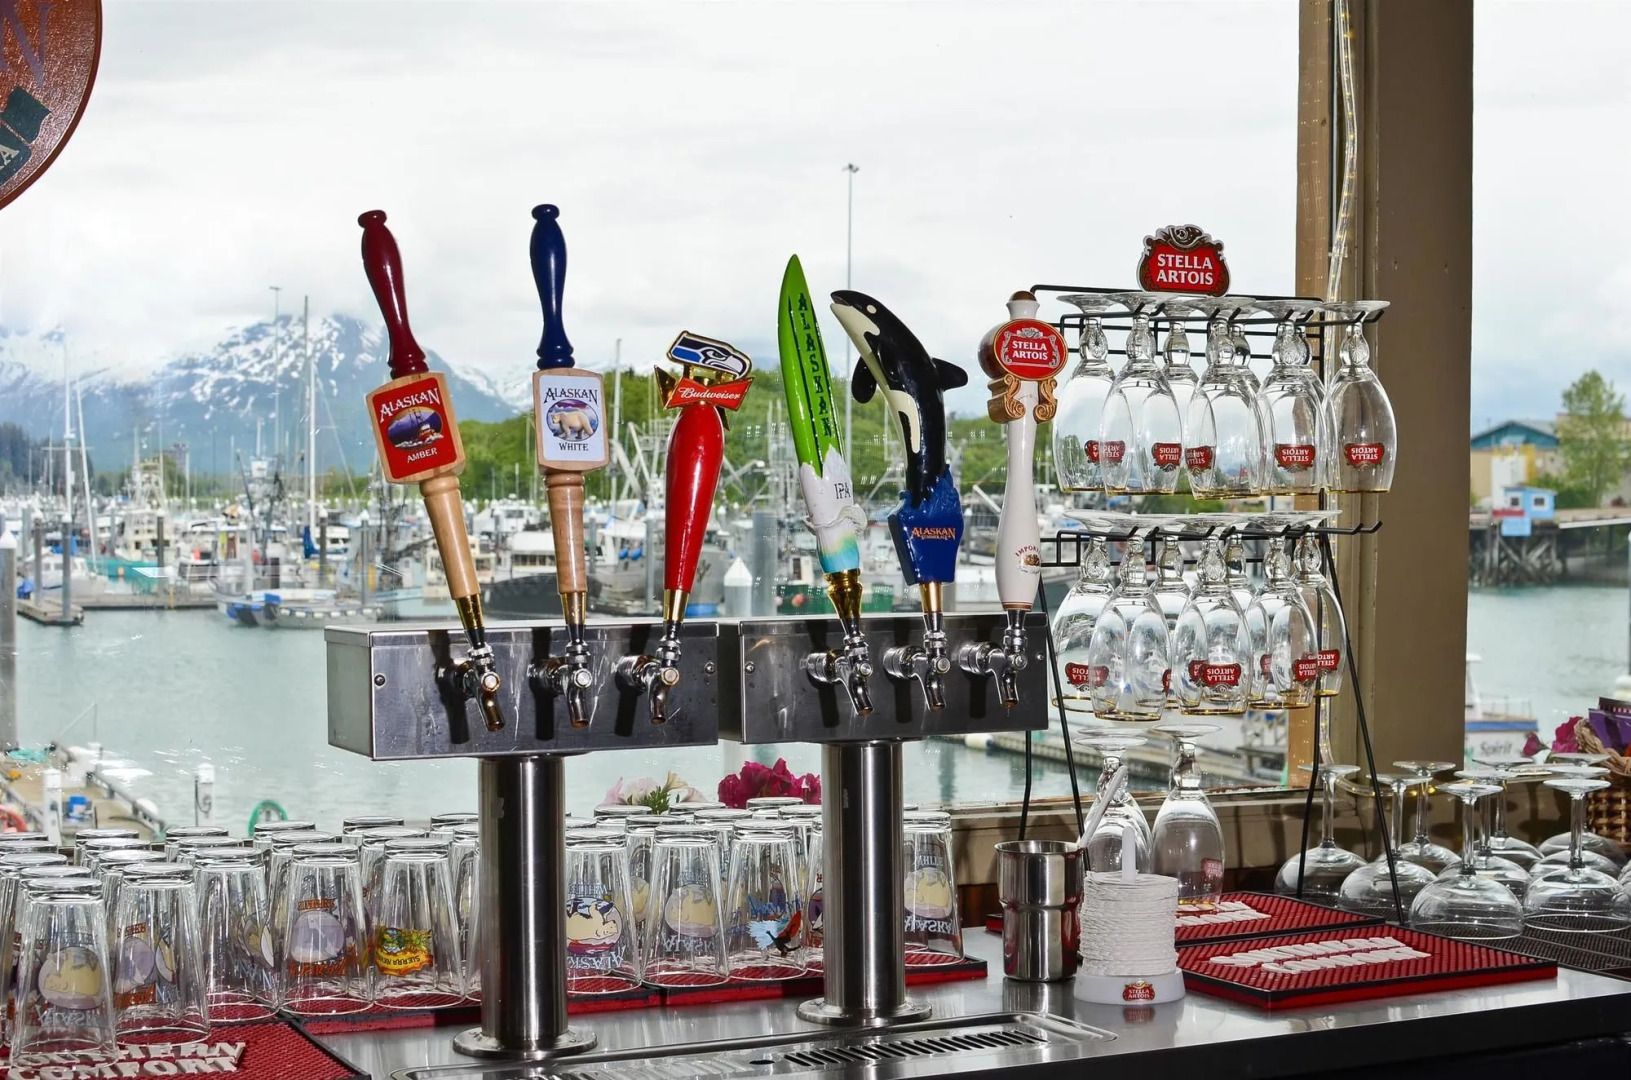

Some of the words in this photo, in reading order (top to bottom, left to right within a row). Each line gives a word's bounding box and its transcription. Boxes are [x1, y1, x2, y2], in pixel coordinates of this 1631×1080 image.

[1157, 253, 1213, 270] STELLA
[1156, 270, 1214, 285] ARTOIS
[1012, 340, 1047, 351] STELLA
[1012, 351, 1048, 360] ARTOIS
[797, 292, 832, 437] ALASKAN
[543, 387, 598, 406] ALASKAN
[678, 387, 741, 399] Budweiser
[380, 387, 441, 423] ALASKAN
[559, 442, 589, 451] WHITE
[407, 447, 438, 463] AMBER
[1281, 454, 1309, 462] STELLA
[834, 483, 851, 499] IPA
[909, 527, 956, 540] ALASKAN
[393, 955, 421, 965] SIERRA
[567, 945, 626, 969] ALASK
